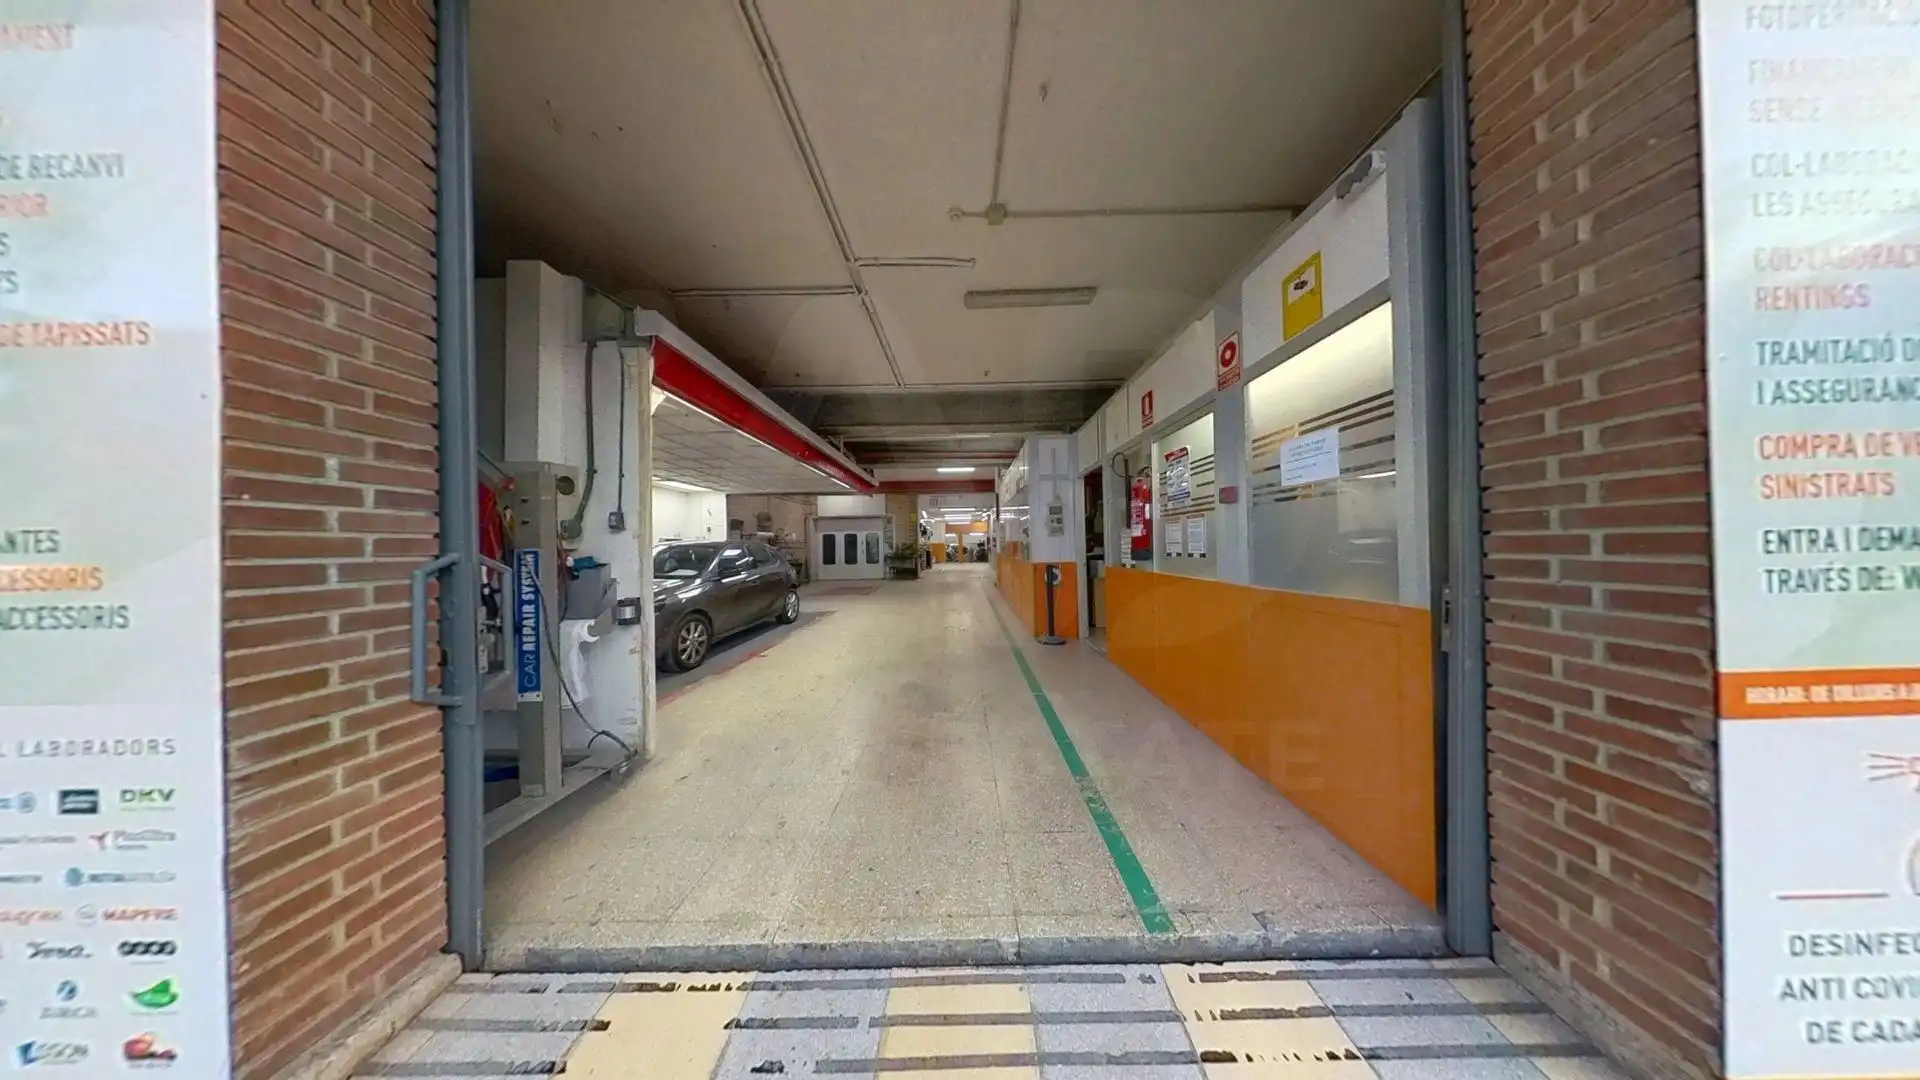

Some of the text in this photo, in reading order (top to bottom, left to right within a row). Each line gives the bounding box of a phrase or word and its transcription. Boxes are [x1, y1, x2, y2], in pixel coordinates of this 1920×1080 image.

[1757, 331, 1894, 366] TRAMITACIÓ
[1759, 433, 1857, 460] COMPRA
[1760, 472, 1895, 499] SINISTRATS
[1763, 527, 1838, 555] ENTRA
[1763, 560, 1851, 594] TRAVÉS
[522, 603, 536, 651] REPAIR
[523, 653, 537, 688] CAR
[119, 788, 176, 804] DKV
[1779, 976, 1846, 1001] ANTI
[1805, 1021, 1843, 1044] DE
